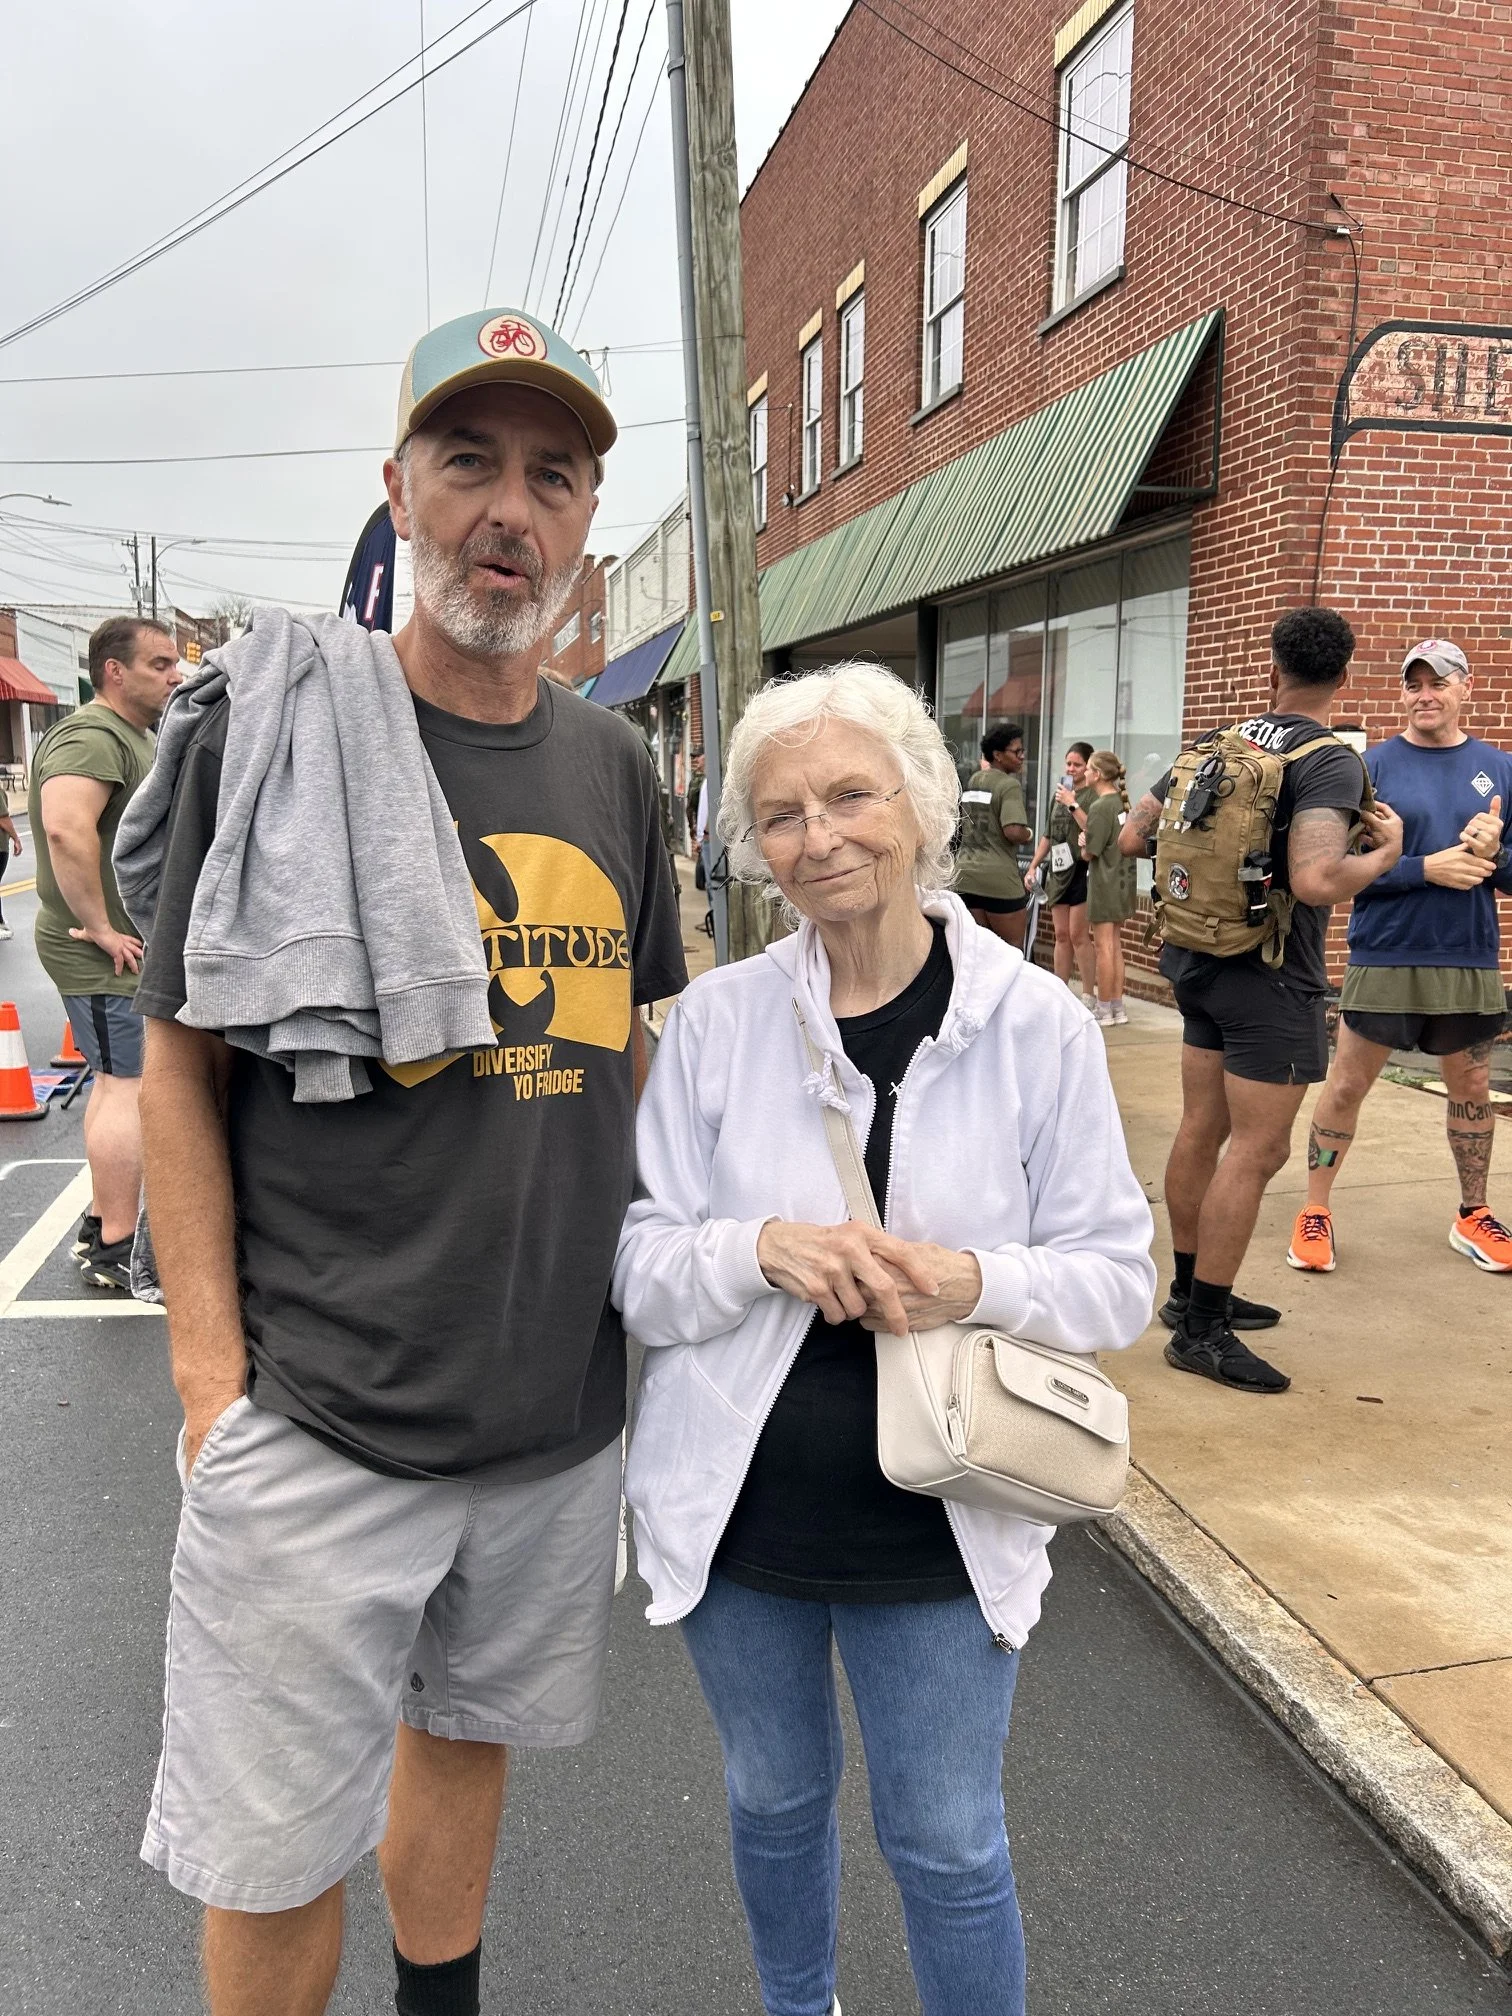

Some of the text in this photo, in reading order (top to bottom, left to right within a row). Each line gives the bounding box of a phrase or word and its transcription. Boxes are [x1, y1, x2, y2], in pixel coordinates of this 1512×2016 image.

[473, 1043, 554, 1078] DIVERSIFY
[513, 1069, 585, 1101] YO FRIDGE
